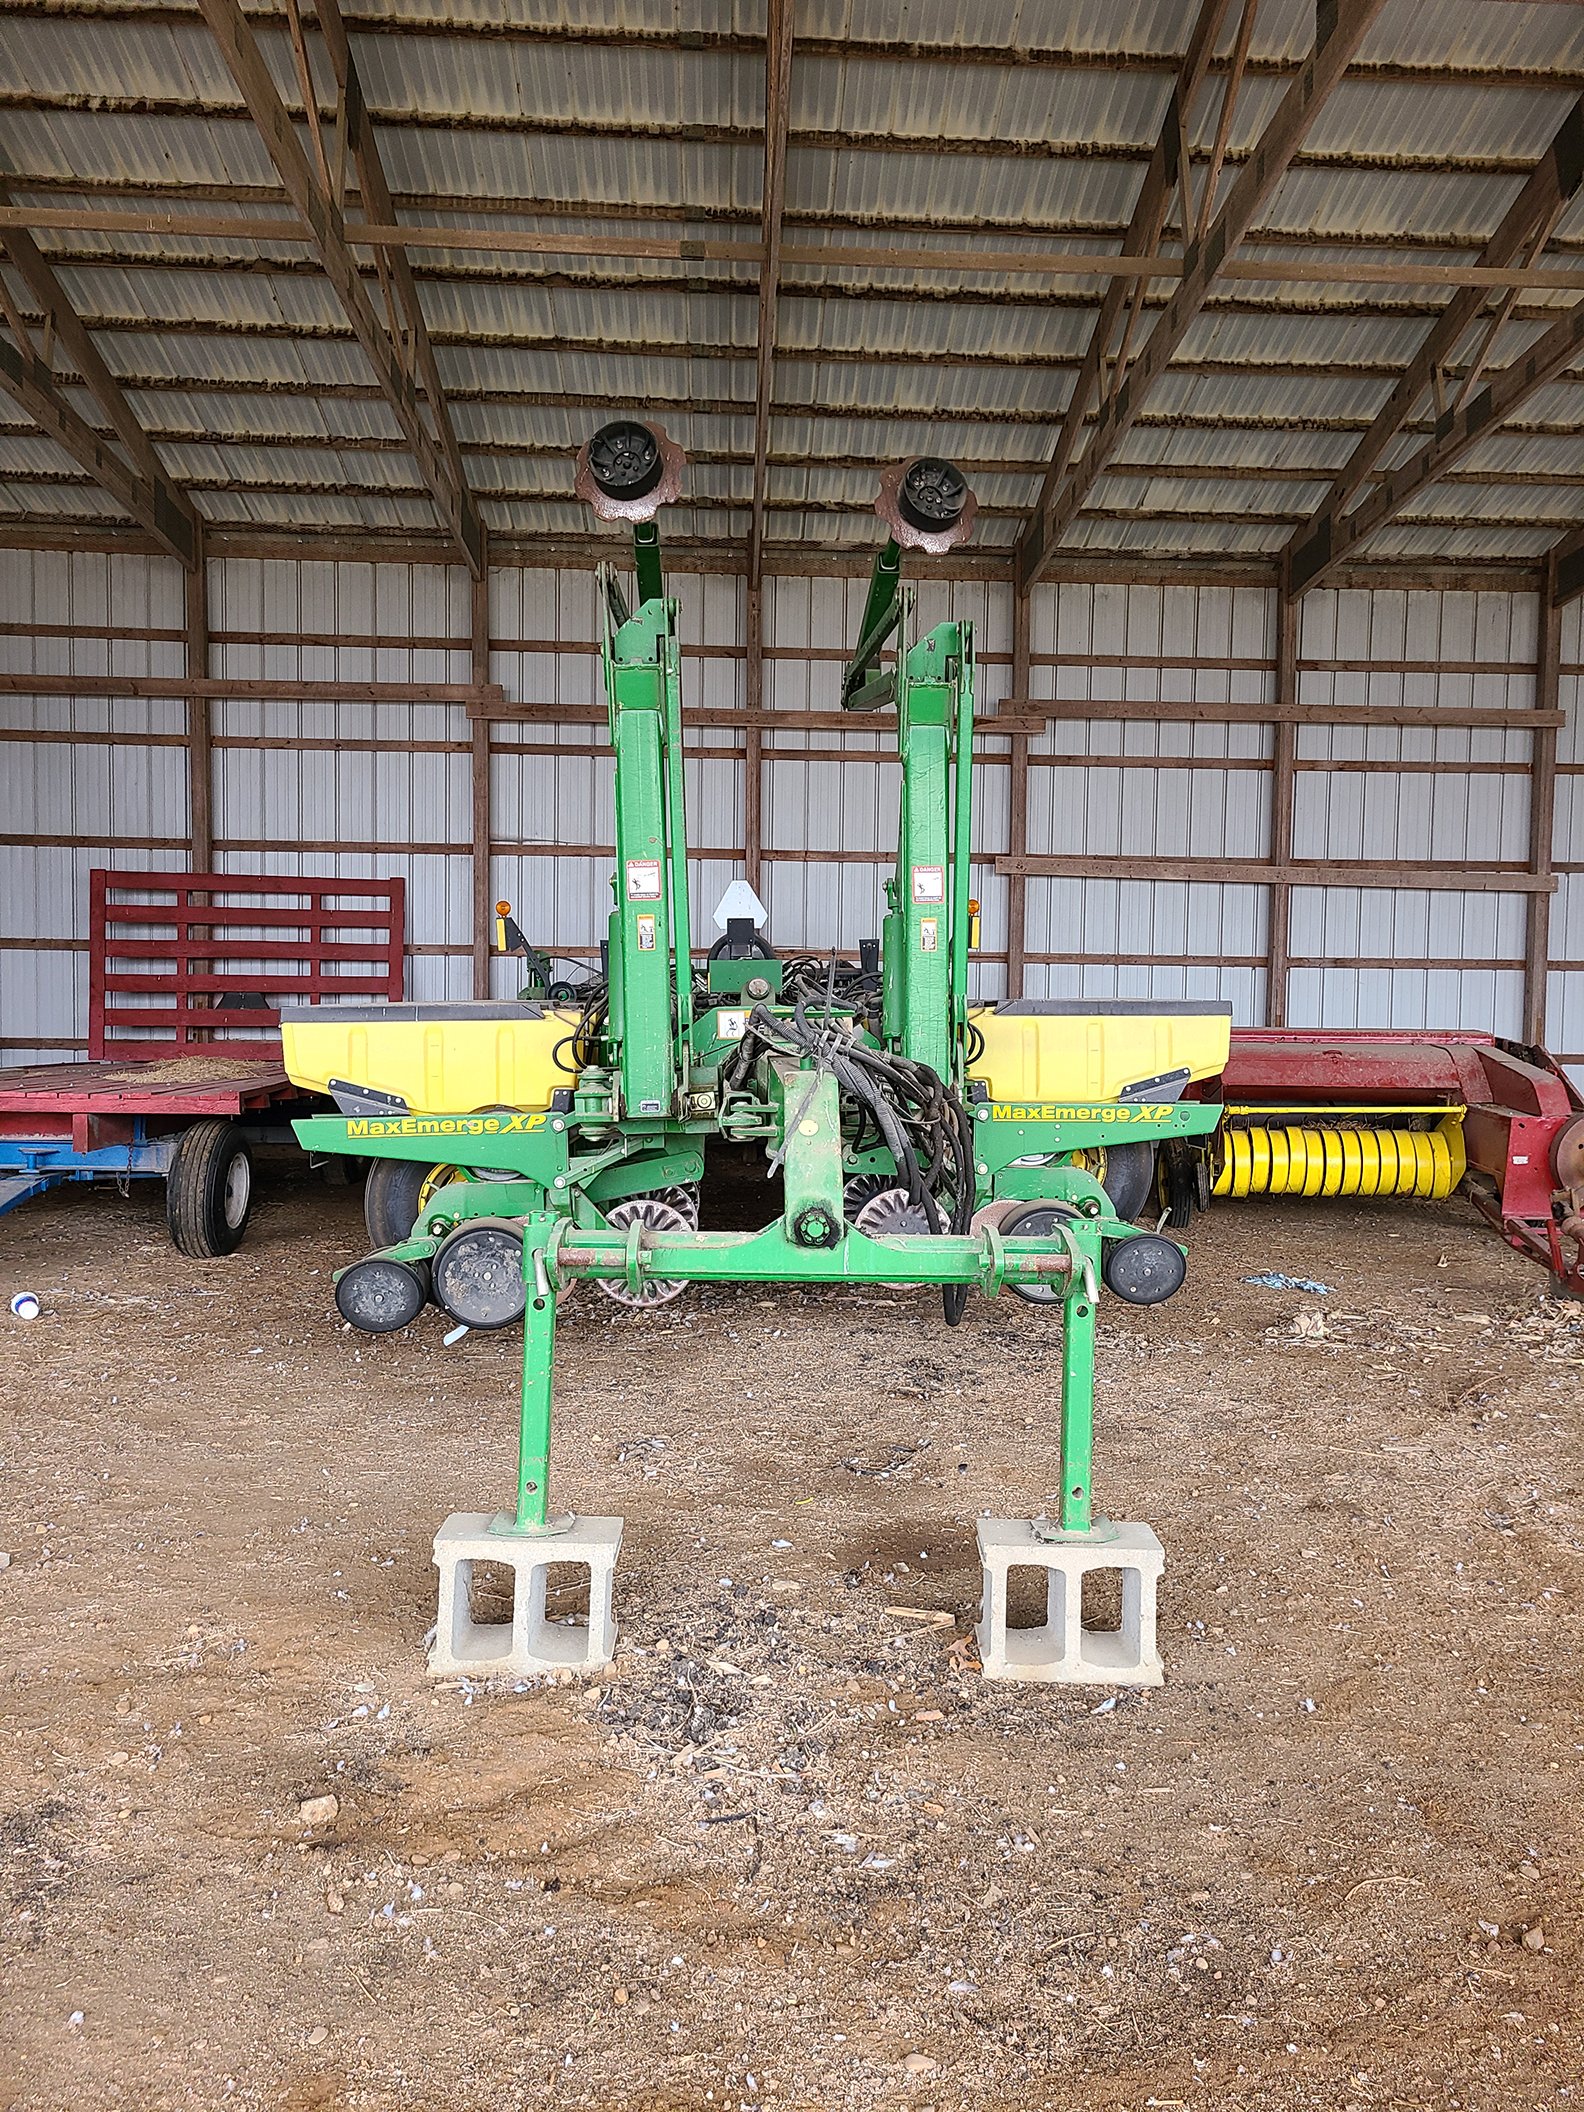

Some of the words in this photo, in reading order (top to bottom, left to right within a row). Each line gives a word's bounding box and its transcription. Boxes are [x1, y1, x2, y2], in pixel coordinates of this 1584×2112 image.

[992, 1105, 1130, 1123] MaxEmerge
[1130, 1105, 1174, 1123] XP
[347, 1118, 499, 1136] MaxEmerge
[499, 1114, 547, 1134] XP
